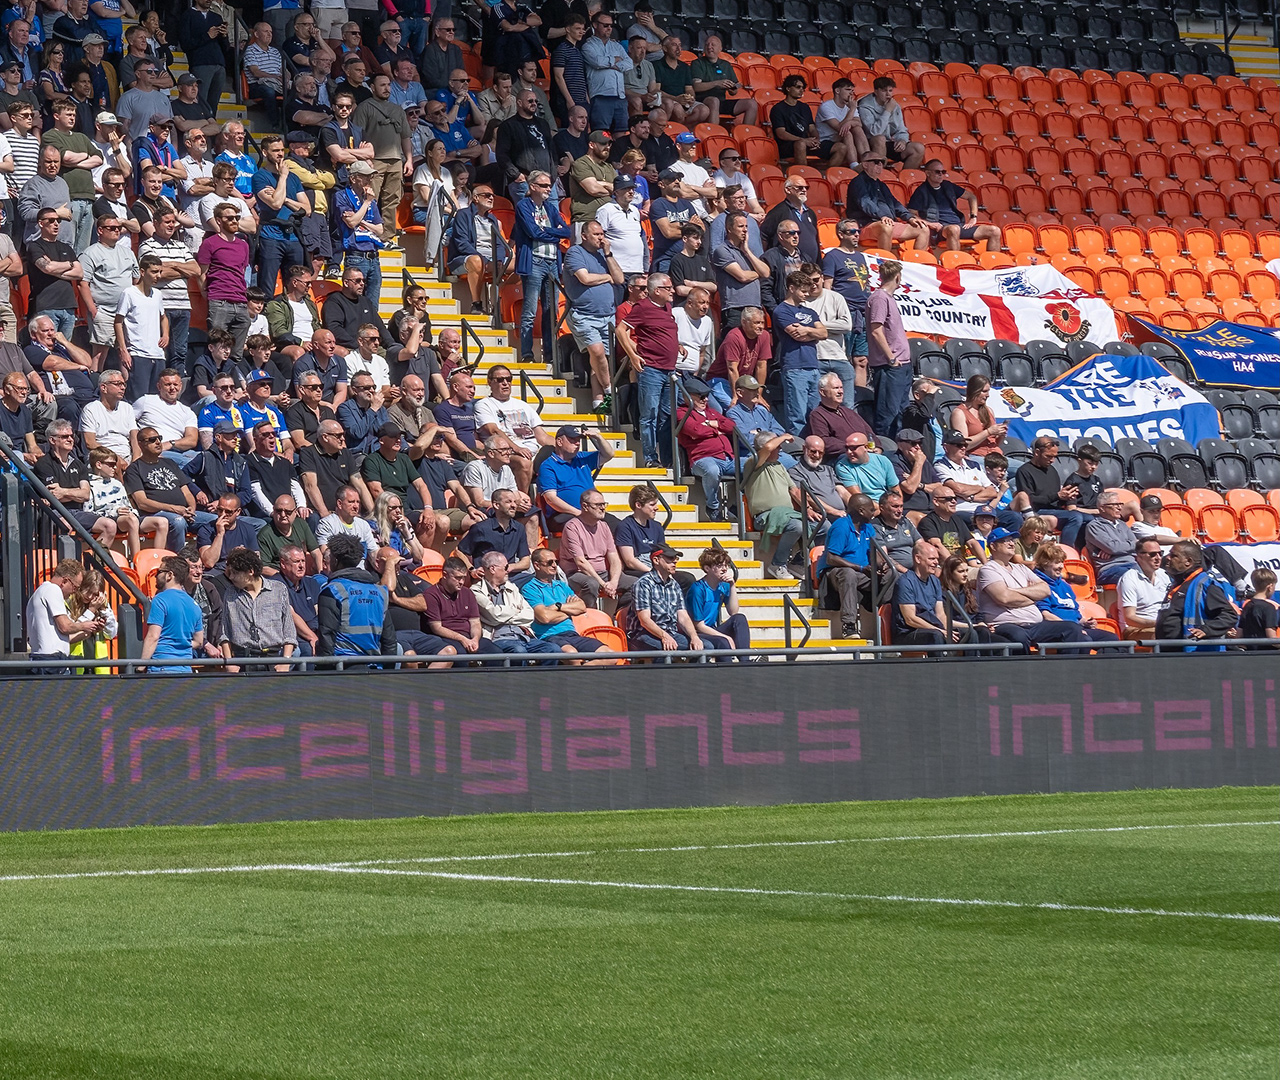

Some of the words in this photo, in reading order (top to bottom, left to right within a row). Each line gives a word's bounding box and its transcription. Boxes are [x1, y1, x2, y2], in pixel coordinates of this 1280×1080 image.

[1232, 360, 1255, 373] HA4
[556, 388, 562, 396] G
[1049, 388, 1137, 410] THE
[616, 441, 621, 449] F
[677, 494, 683, 502] E
[101, 692, 861, 796] intelligiants
